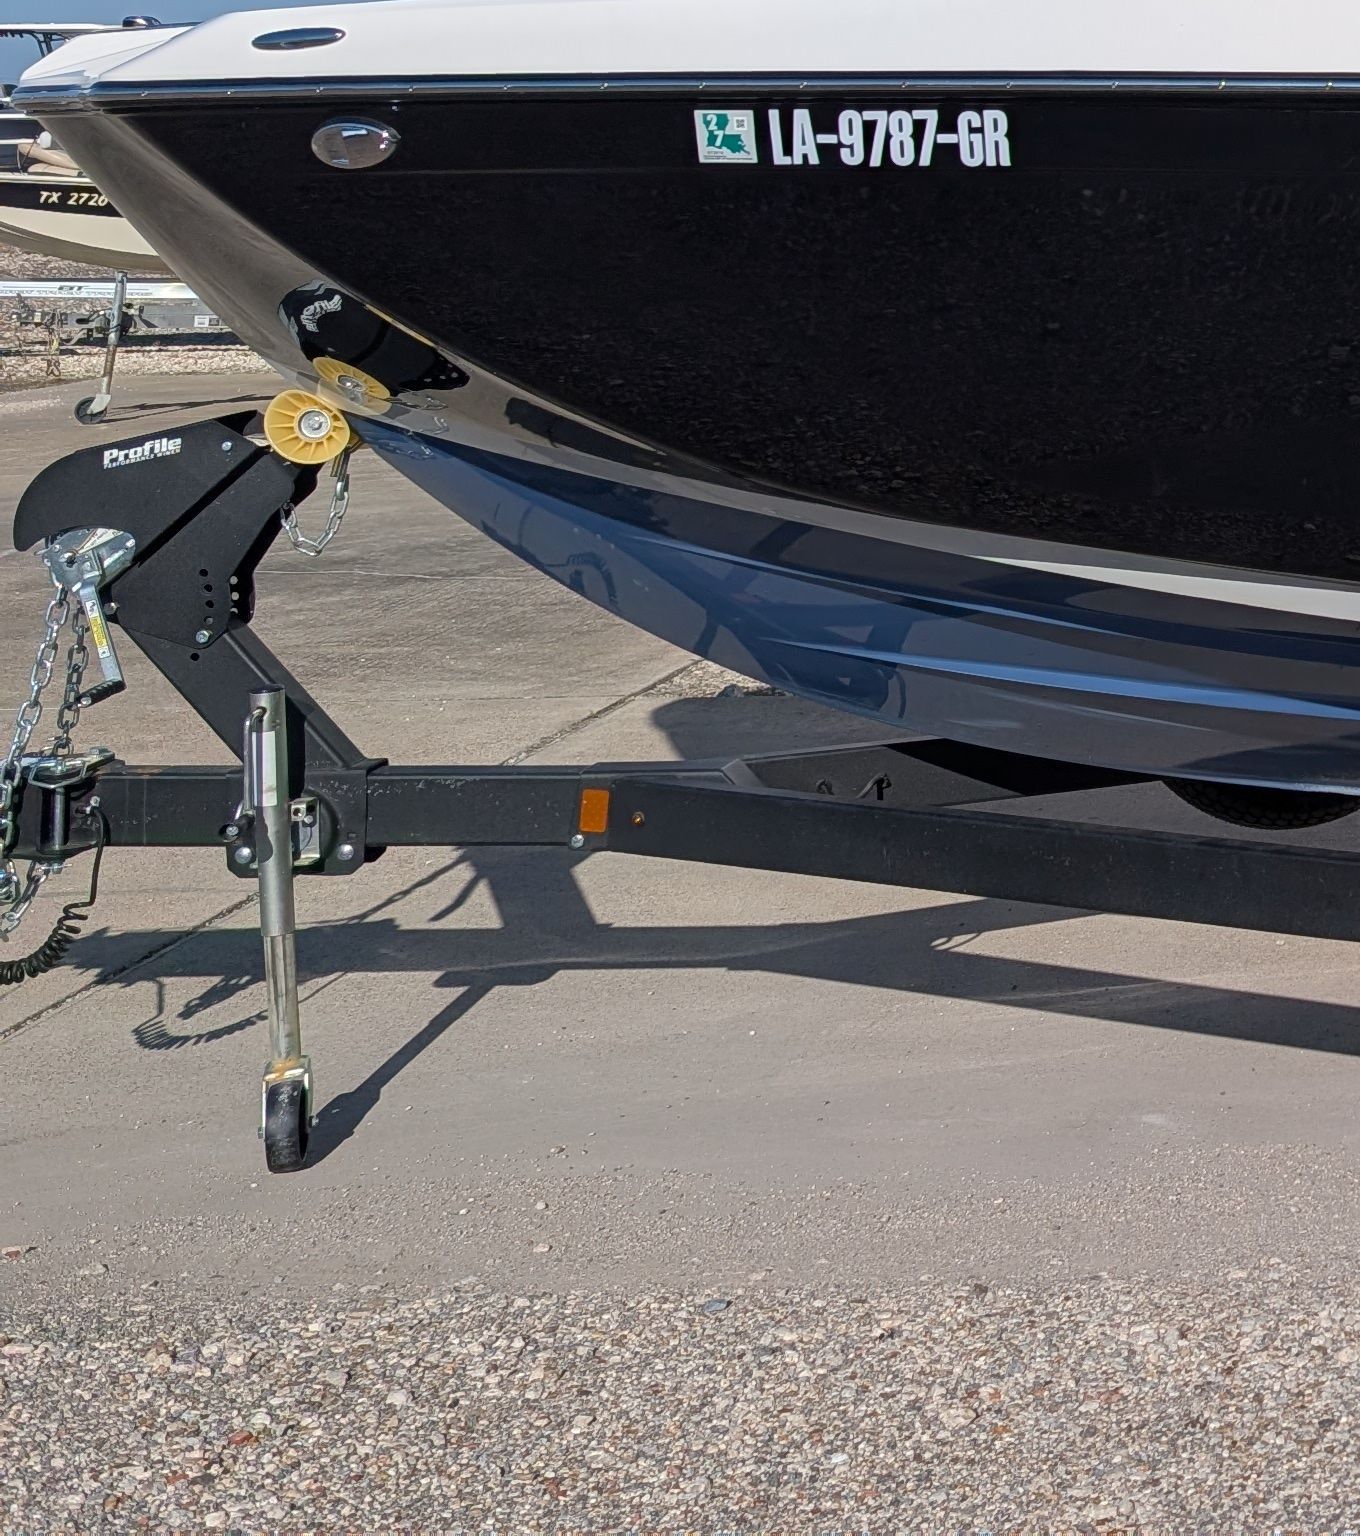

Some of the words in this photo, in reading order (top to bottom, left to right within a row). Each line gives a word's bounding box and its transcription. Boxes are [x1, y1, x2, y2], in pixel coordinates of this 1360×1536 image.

[767, 109, 1012, 167] LA-9787-GR
[39, 191, 62, 204] TX
[103, 437, 182, 465] Profile
